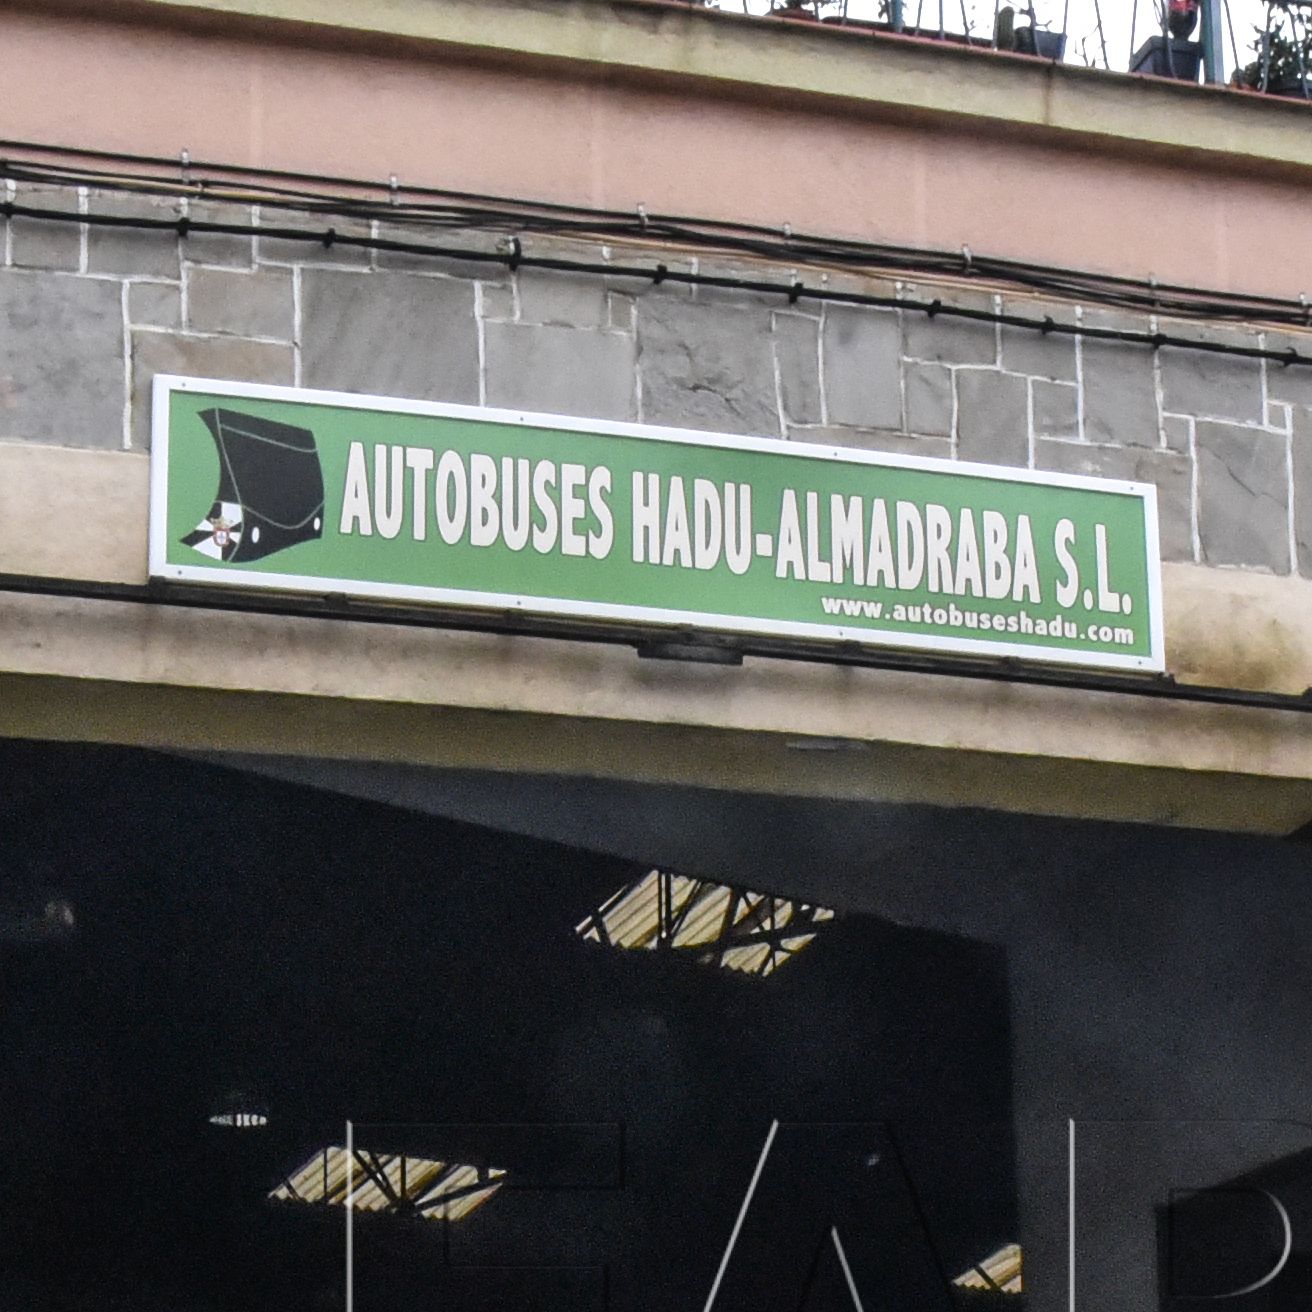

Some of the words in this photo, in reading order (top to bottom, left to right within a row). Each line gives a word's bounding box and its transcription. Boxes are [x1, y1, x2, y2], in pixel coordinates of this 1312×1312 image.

[339, 441, 614, 560] AUTOBUSES
[632, 471, 1041, 604] HADU-ALMADRABA
[1054, 518, 1133, 616] S.L.
[821, 597, 1135, 645] www.autobuseshadu.com
